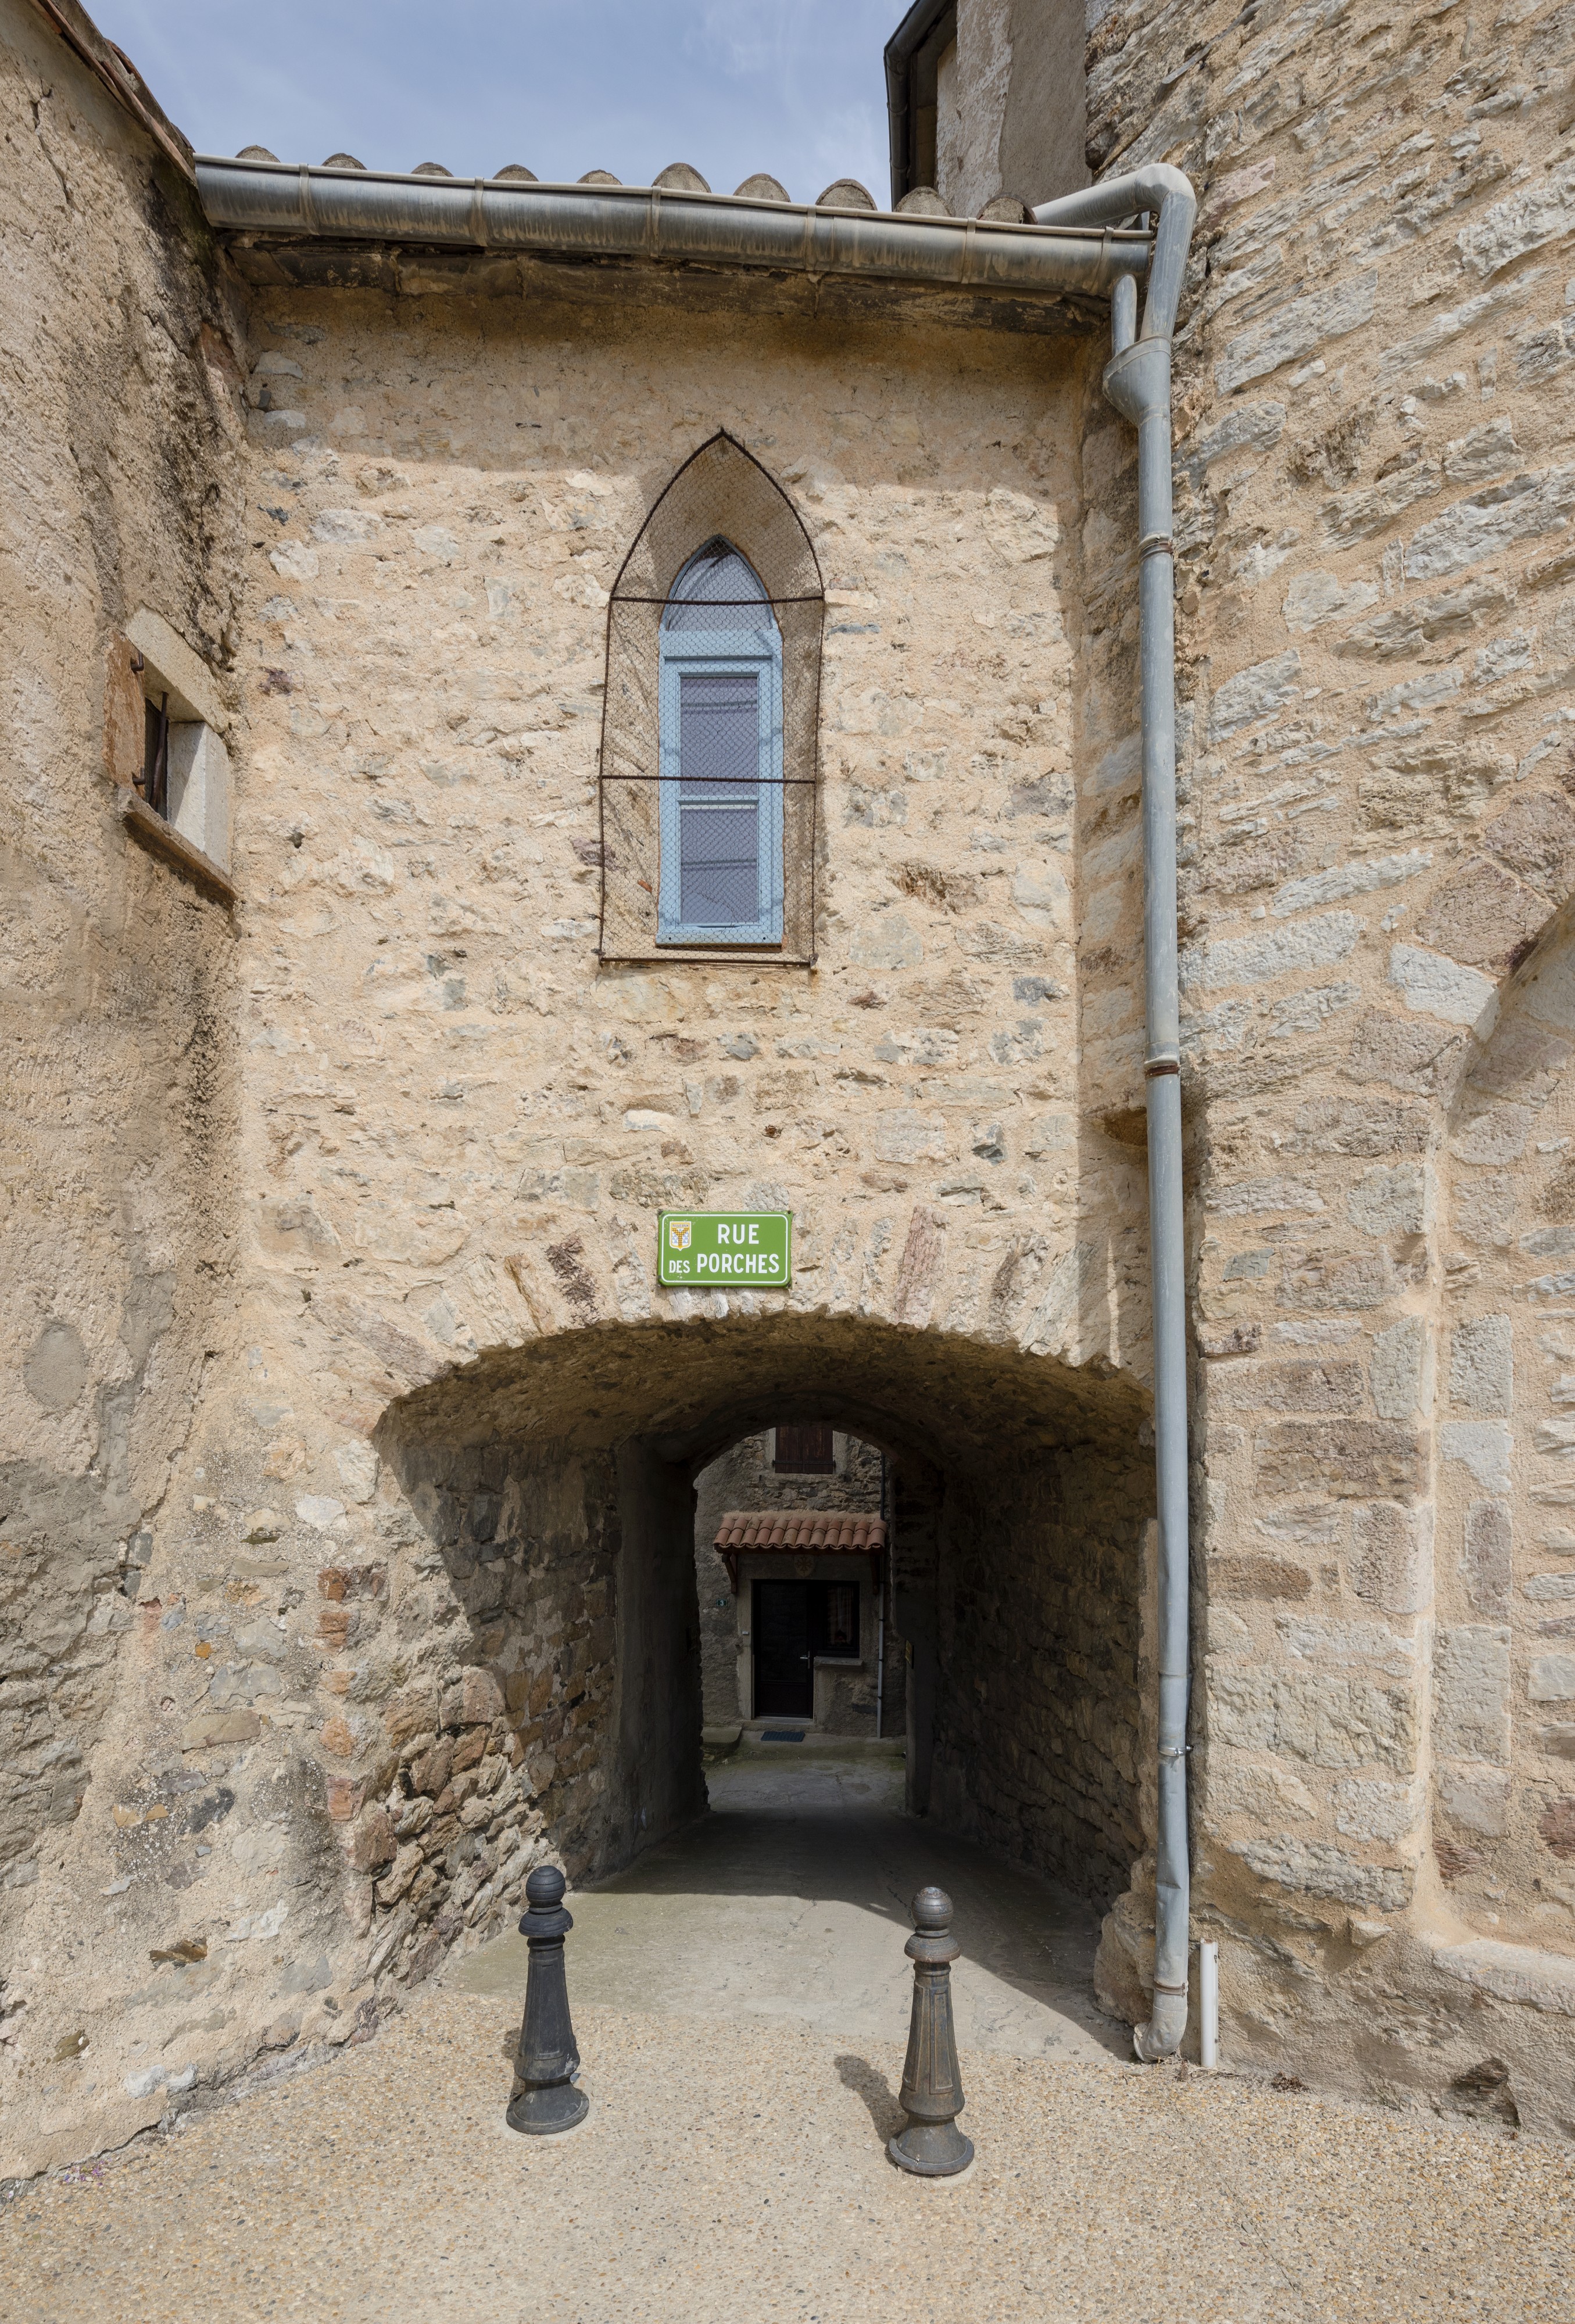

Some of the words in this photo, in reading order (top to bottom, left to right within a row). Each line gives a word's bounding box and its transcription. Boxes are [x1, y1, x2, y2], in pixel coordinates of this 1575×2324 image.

[718, 1224, 759, 1245] RUE
[669, 1260, 690, 1274] DES
[697, 1253, 779, 1274] PORCHES
